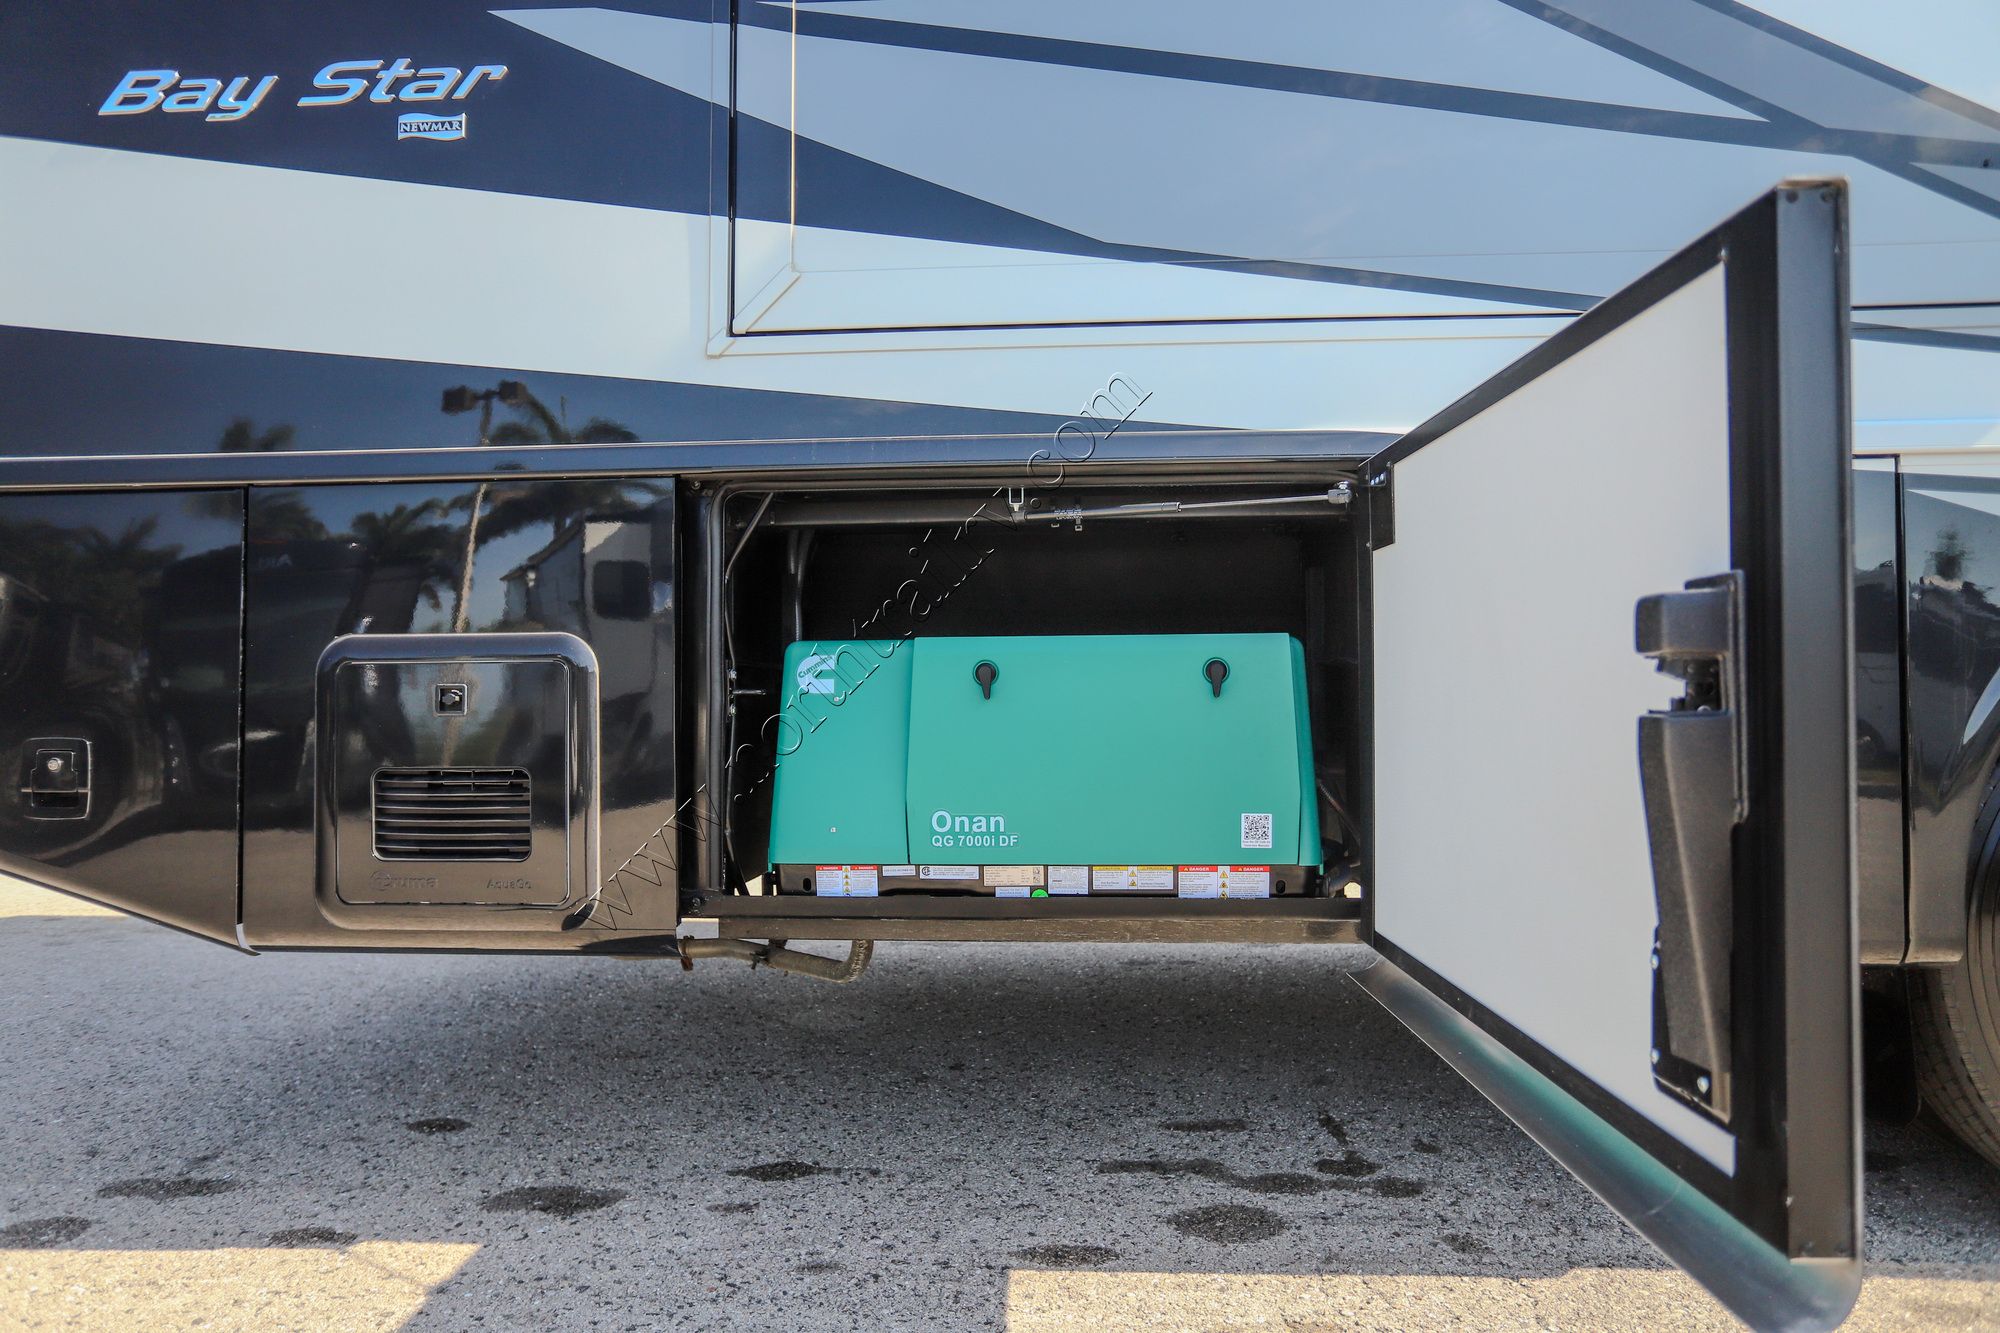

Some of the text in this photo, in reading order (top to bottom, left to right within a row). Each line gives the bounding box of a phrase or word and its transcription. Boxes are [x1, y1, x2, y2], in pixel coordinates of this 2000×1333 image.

[98, 58, 508, 122] Bay Star
[400, 121, 462, 132] NEWMAR
[931, 810, 1005, 833] Onan
[932, 835, 1018, 847] QG 7000i DF
[486, 878, 532, 890] AquaGo
